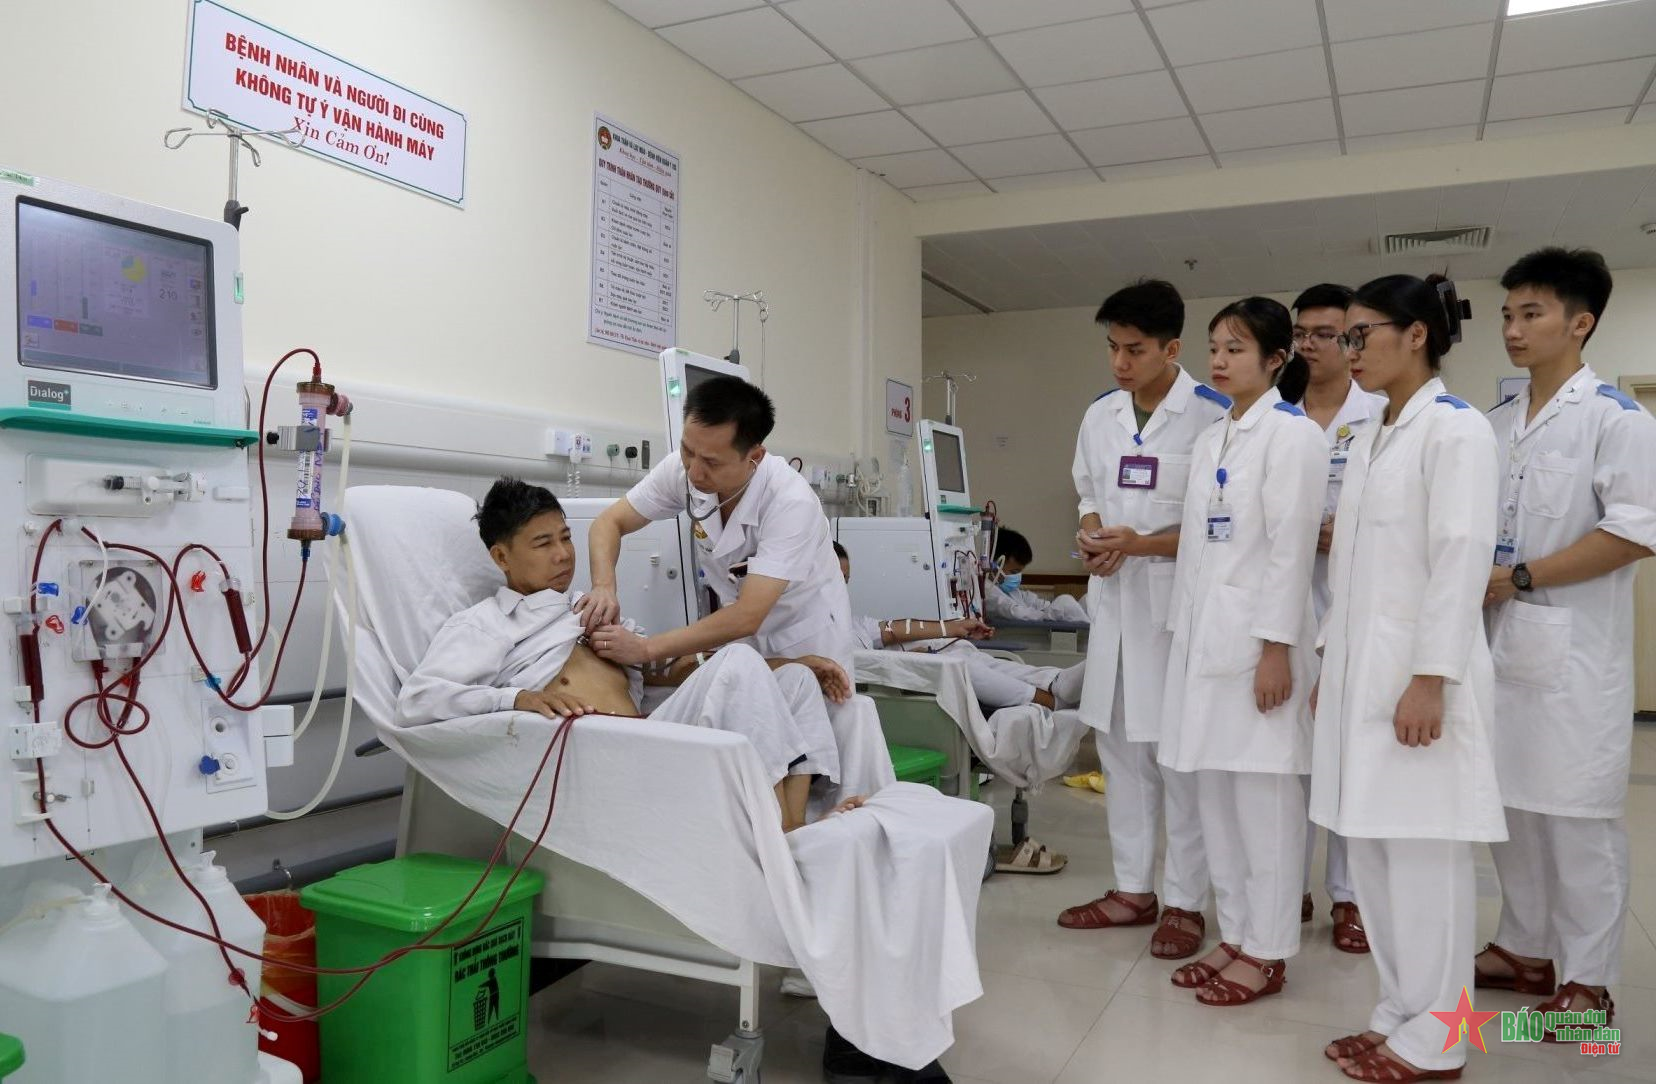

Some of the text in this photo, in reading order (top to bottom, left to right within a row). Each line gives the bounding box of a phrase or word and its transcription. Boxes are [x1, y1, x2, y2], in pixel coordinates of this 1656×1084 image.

[225, 32, 445, 140] BỆNH NHÂN VÀ NGƯỜI ĐI CÙNG
[235, 67, 435, 161] KHÔNG TỰ Ý VẬN HÀNH MÁY
[292, 116, 390, 166] Xin Cảm Ơn!
[905, 397, 910, 423] 3
[455, 967, 465, 984] RÁC
[467, 957, 479, 978] THẢI
